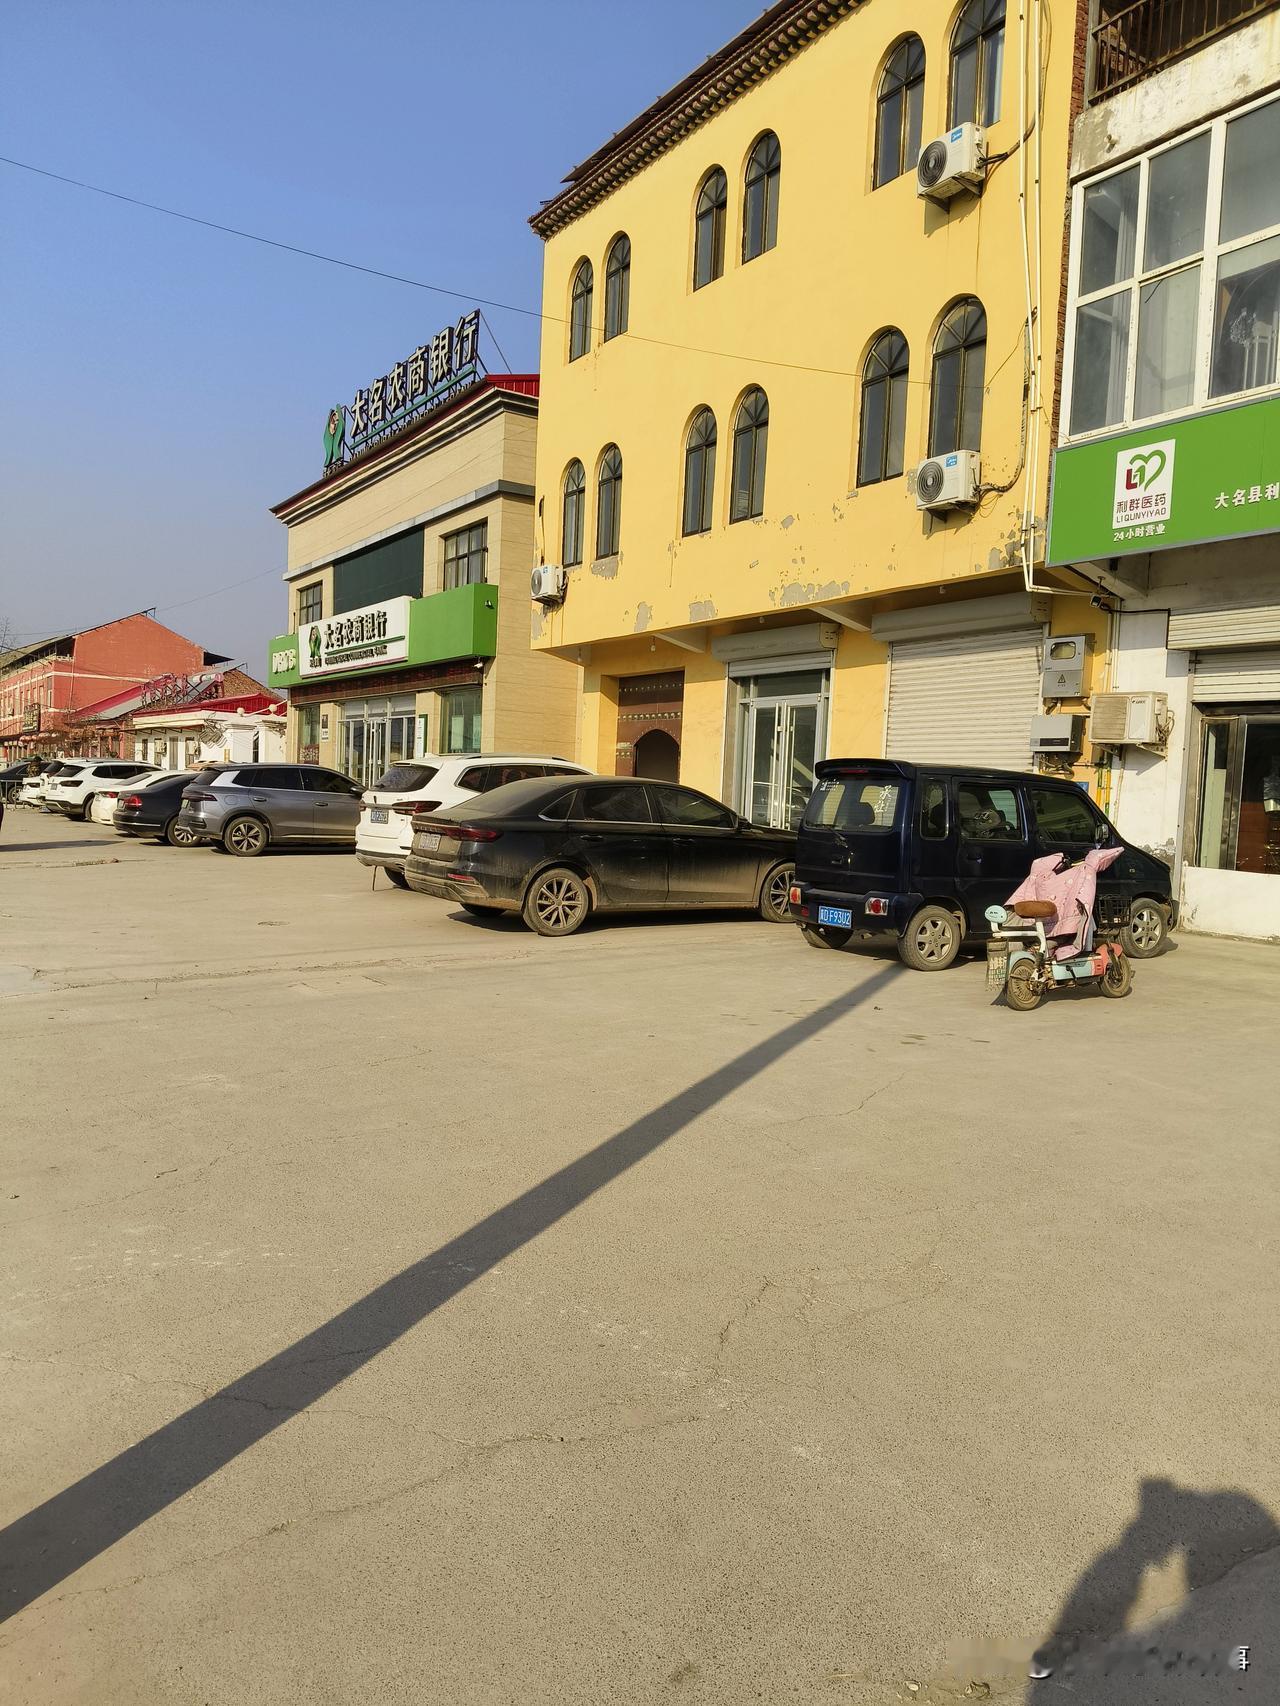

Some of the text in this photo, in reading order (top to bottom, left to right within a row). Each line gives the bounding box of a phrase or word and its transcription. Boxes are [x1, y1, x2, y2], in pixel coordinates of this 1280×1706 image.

[350, 310, 478, 438] 大名农商银行
[1116, 493, 1166, 514] 利群医药
[1214, 482, 1280, 509] 大名县利
[1116, 507, 1166, 523] LIQUNYIYAO
[1113, 523, 1166, 542] 24小时营业
[324, 611, 388, 649] 大名农商银行
